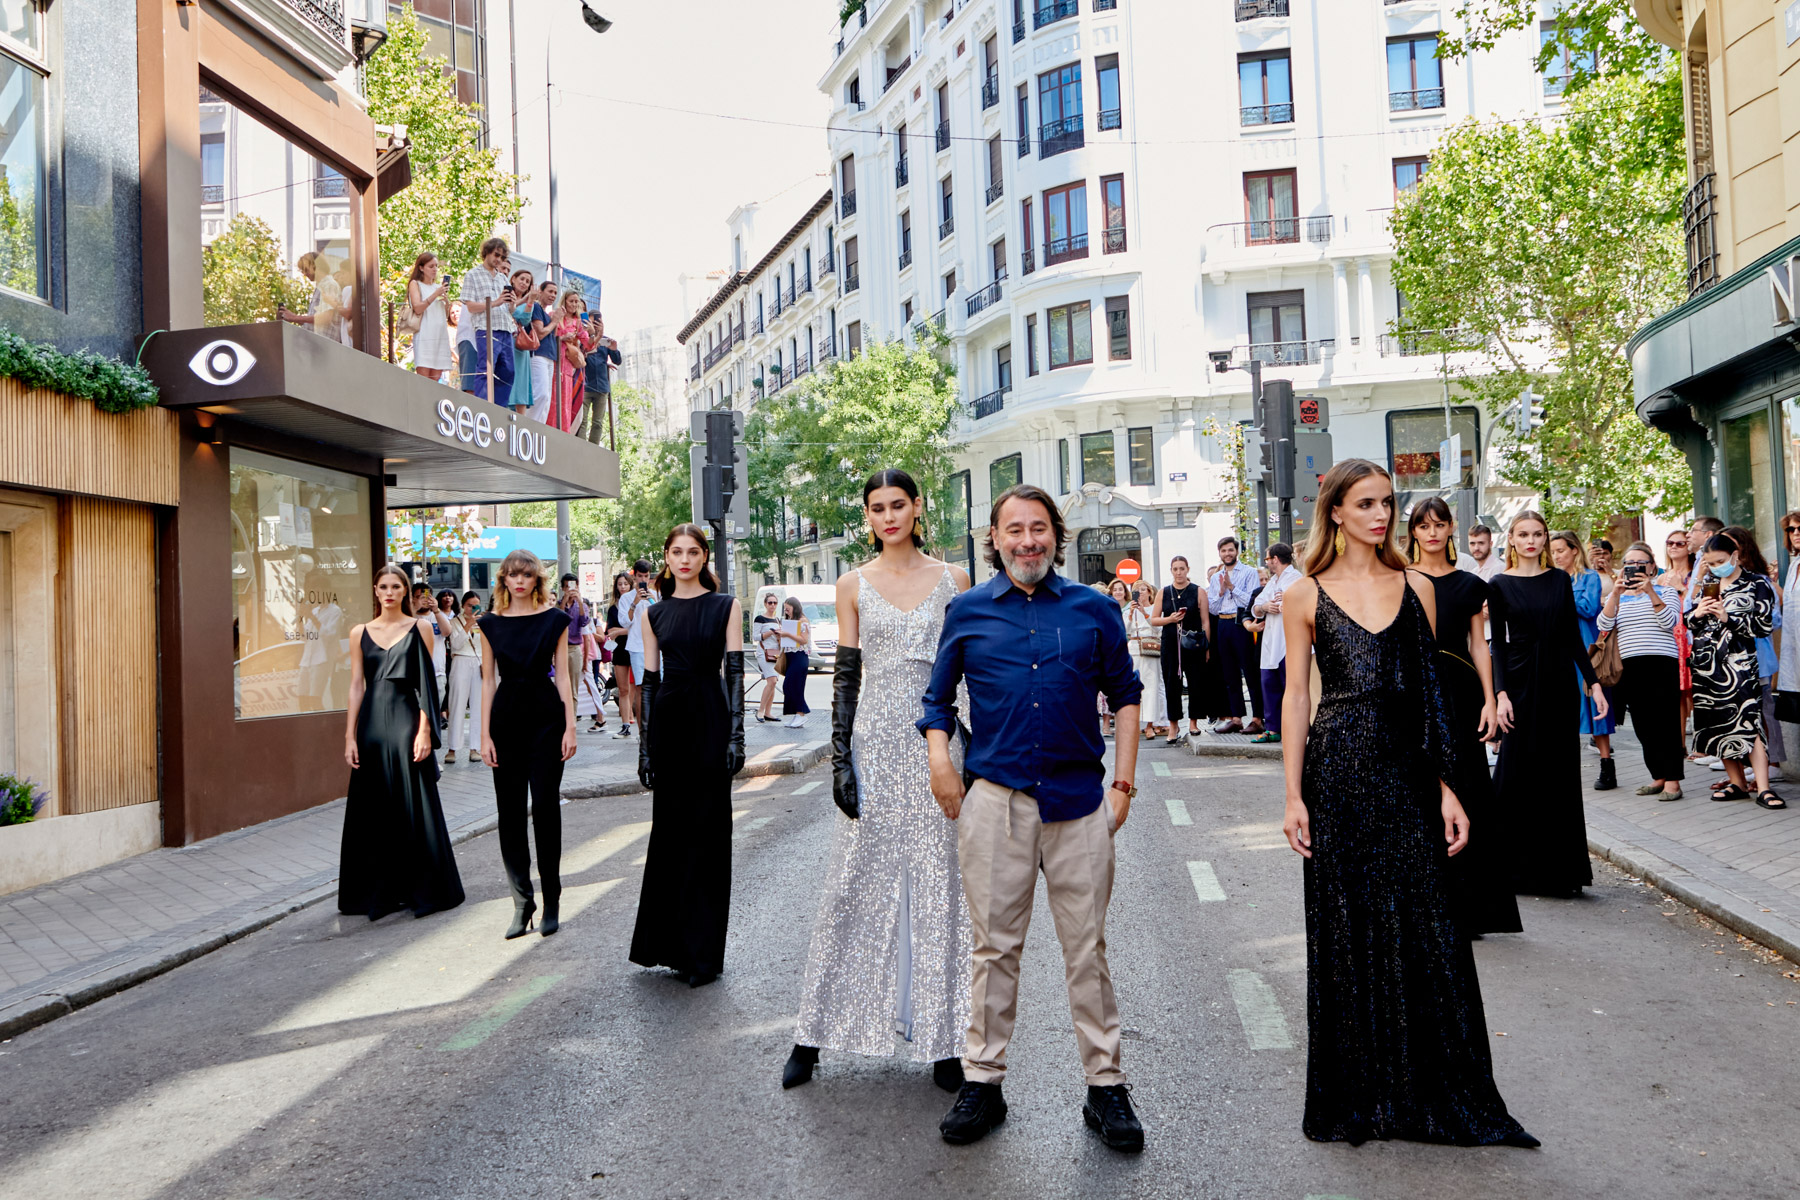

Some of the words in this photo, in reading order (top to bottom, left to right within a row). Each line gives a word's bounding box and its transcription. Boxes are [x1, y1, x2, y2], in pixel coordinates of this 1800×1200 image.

[437, 399, 491, 448] see
[509, 413, 546, 465] iou
[309, 590, 339, 605] OLIVA
